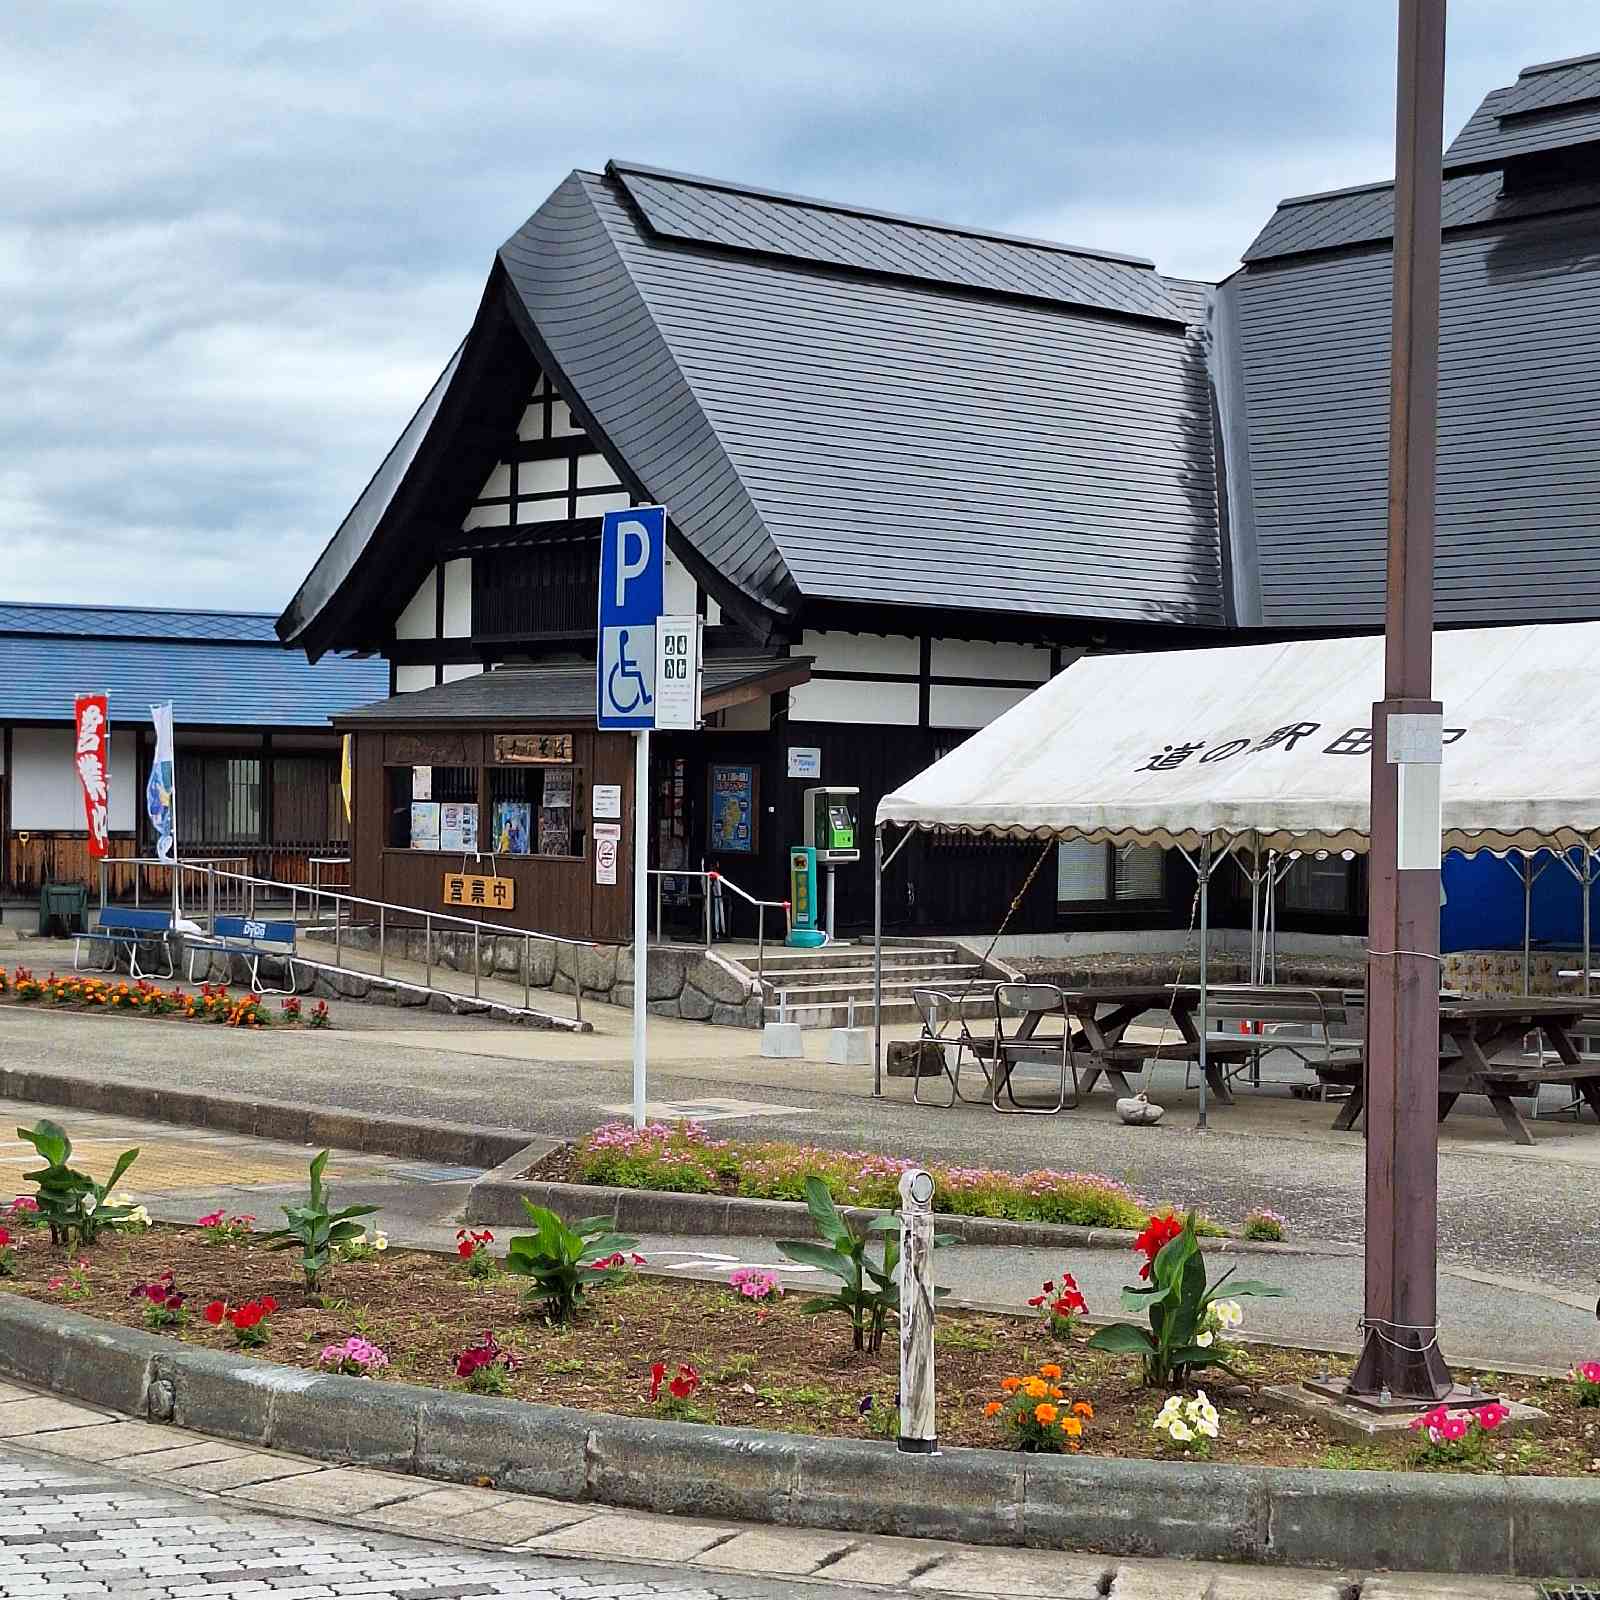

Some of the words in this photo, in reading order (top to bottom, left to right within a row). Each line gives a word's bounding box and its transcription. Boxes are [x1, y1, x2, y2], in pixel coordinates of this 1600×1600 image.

[615, 521, 651, 607] P
[451, 878, 507, 905] 営業中
